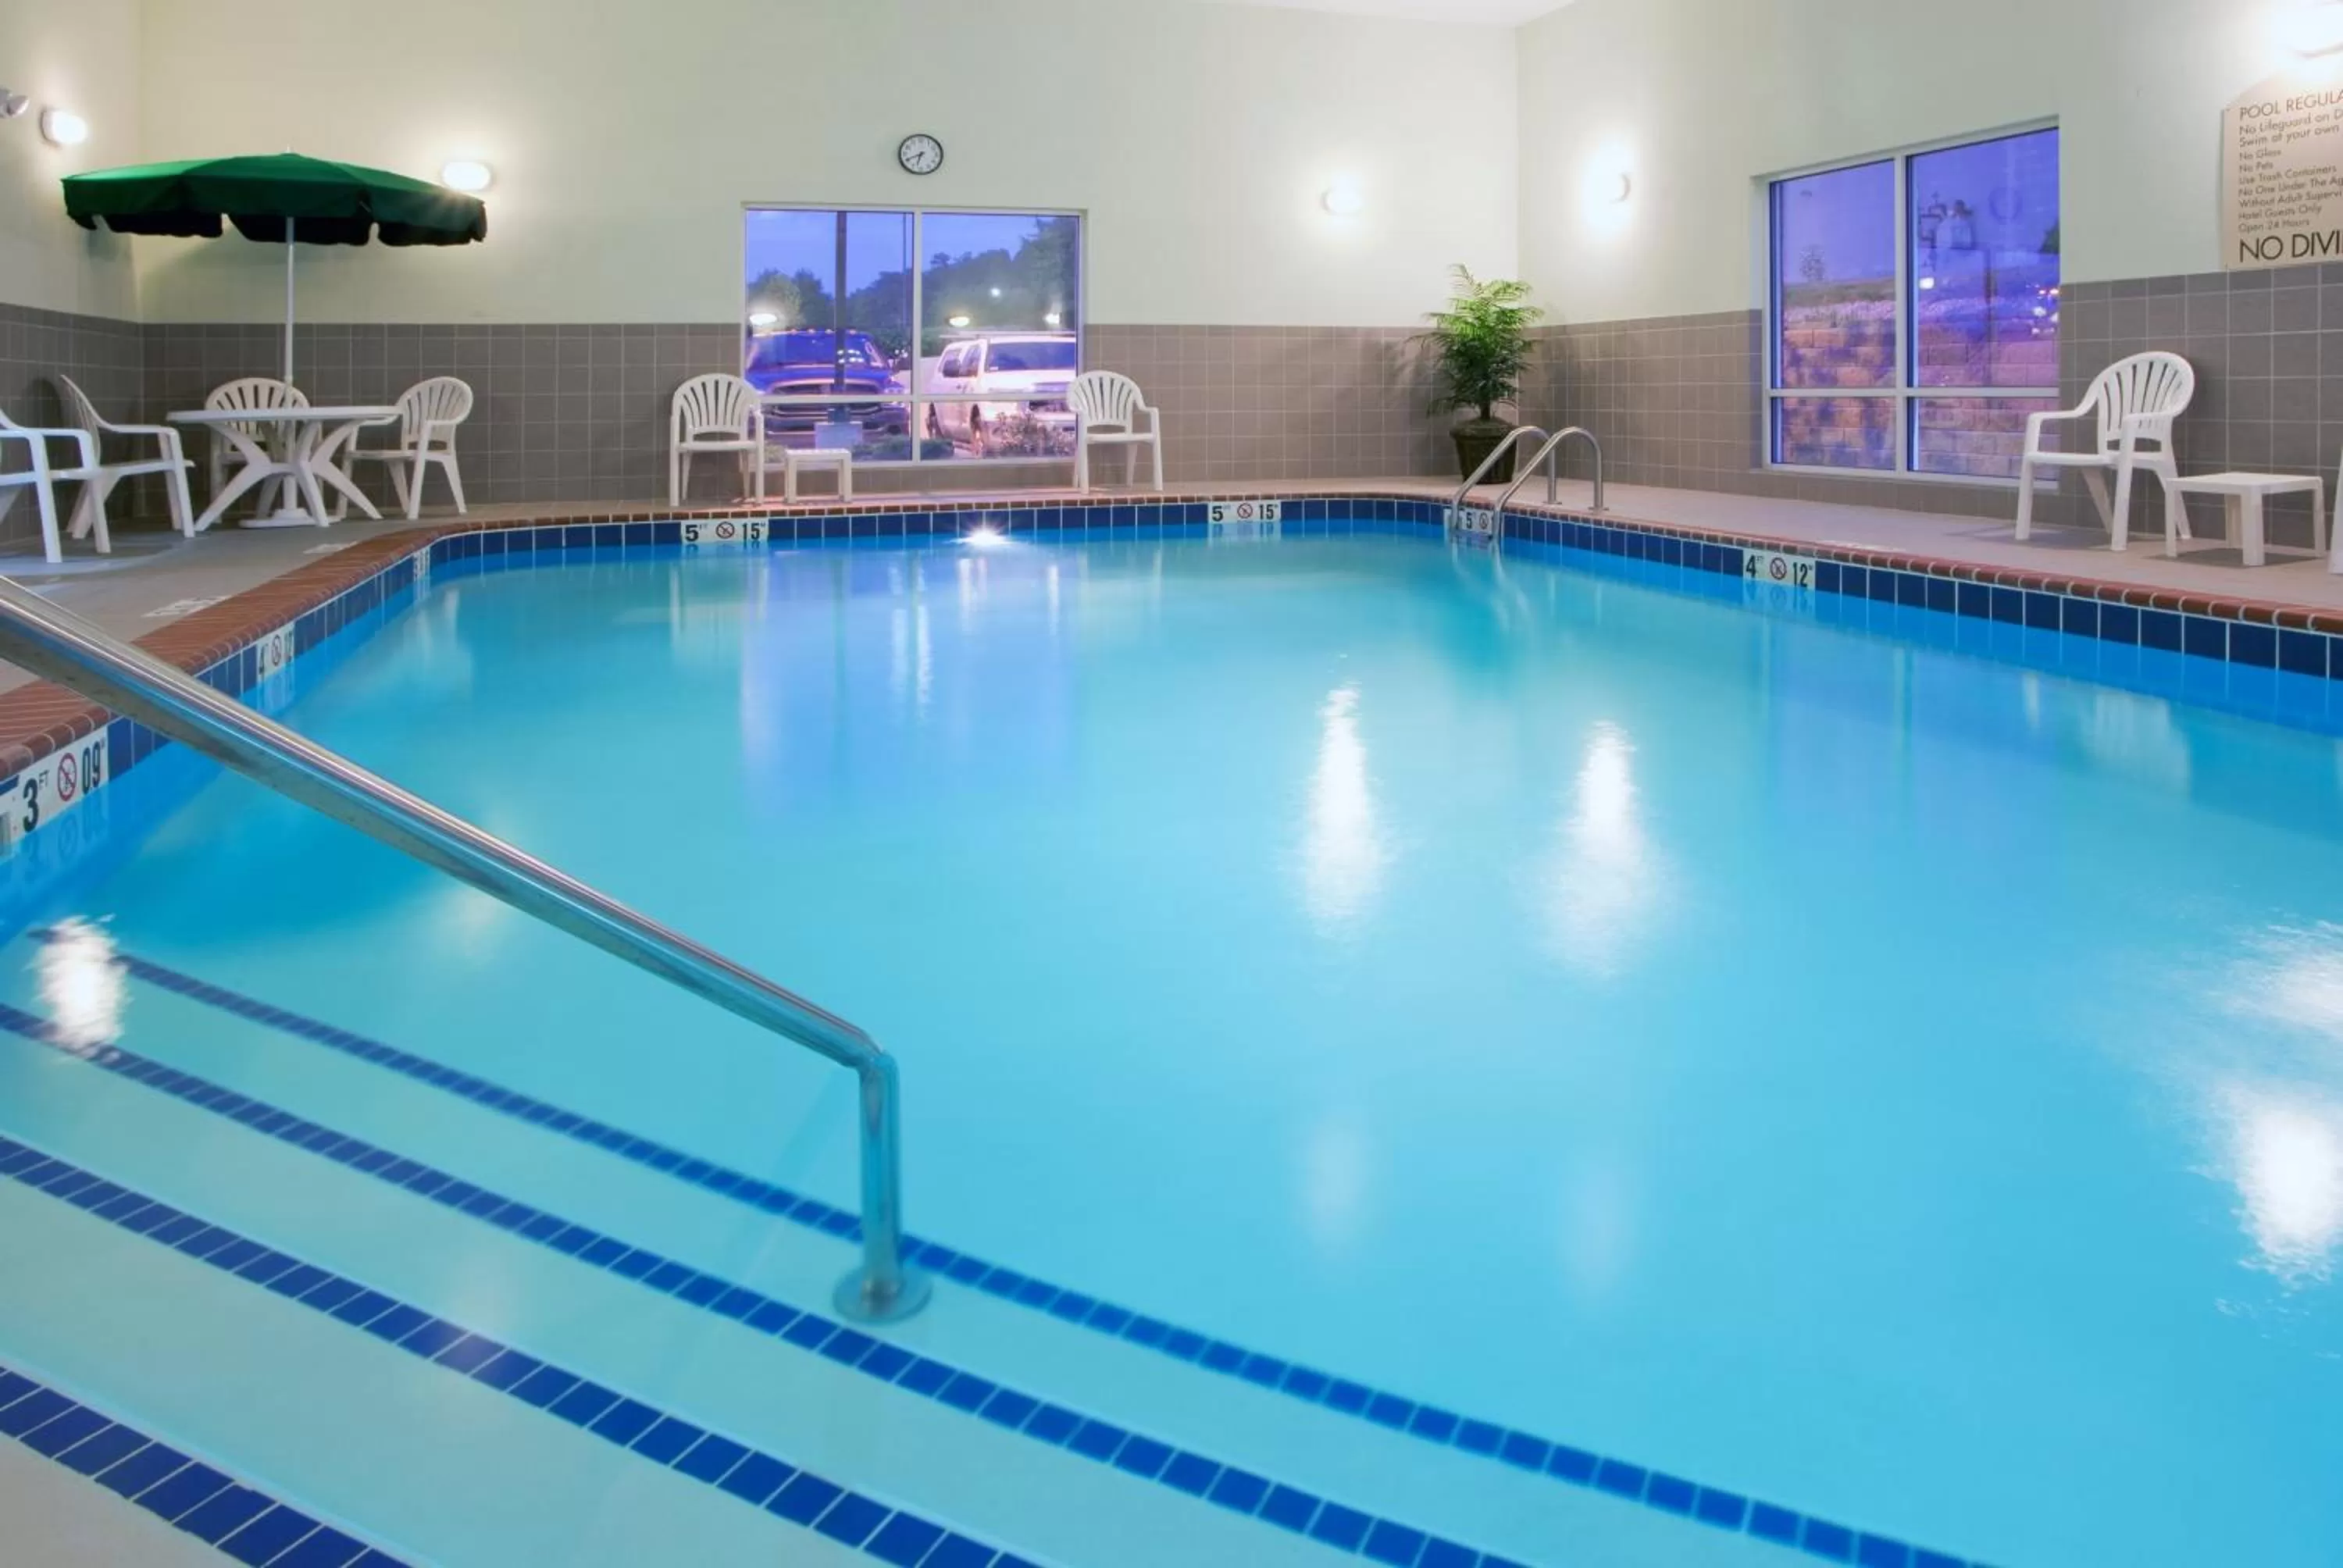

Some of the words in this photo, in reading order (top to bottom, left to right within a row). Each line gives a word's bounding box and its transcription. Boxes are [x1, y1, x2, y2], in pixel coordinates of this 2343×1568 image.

[2239, 100, 2281, 122] POOL
[2239, 124, 2256, 135] No
[2314, 114, 2330, 123] on
[2239, 135, 2268, 148] Swim
[2286, 128, 2311, 144] your
[2314, 124, 2340, 135] own
[2239, 151, 2253, 161] No
[2239, 164, 2253, 173] No
[2238, 187, 2253, 197] No
[2239, 235, 2284, 263] NO
[2291, 229, 2343, 258] DIVI
[1212, 505, 1224, 522] 5
[685, 524, 699, 542] 5
[1746, 554, 1756, 578] 4
[23, 778, 39, 832] 3
